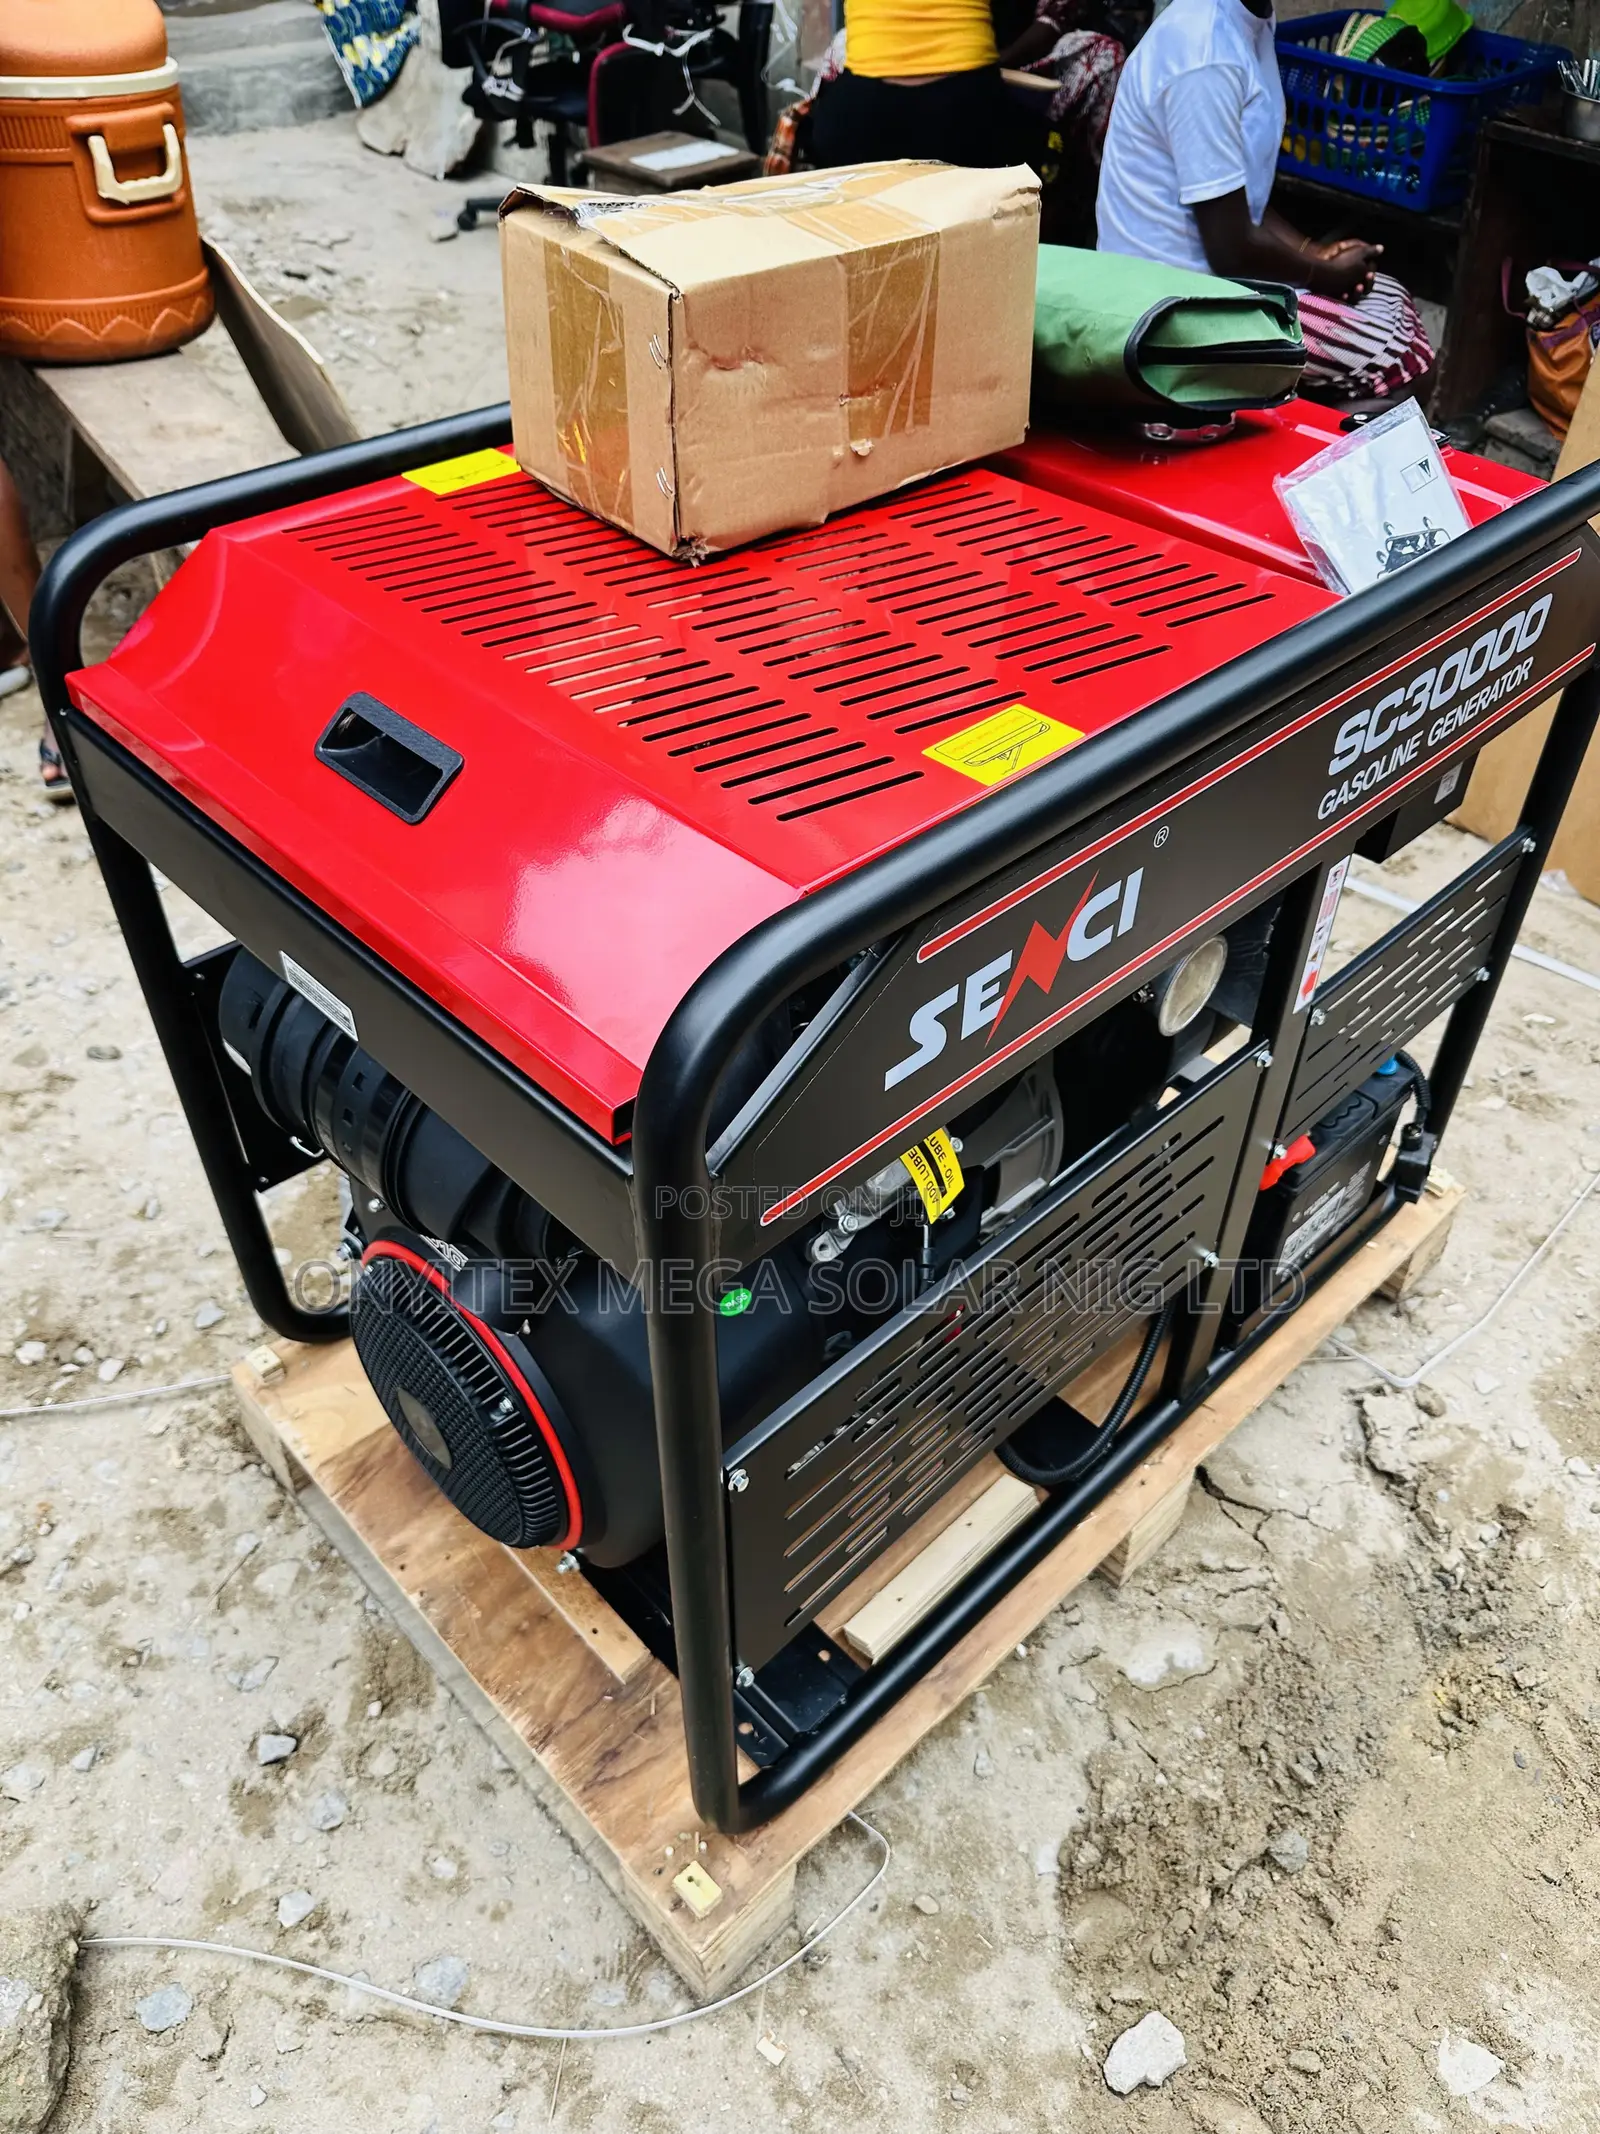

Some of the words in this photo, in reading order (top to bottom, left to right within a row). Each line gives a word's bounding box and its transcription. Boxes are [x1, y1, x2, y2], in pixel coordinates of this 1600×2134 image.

[1328, 593, 1553, 776] SC30000
[1317, 730, 1424, 820] GASOLINE
[1427, 656, 1534, 747] GENERATOR
[884, 867, 1145, 1092] SENCI
[908, 1148, 930, 1181] LUBE
[926, 1180, 940, 1204] ADD
[724, 1292, 749, 1310] PASS
